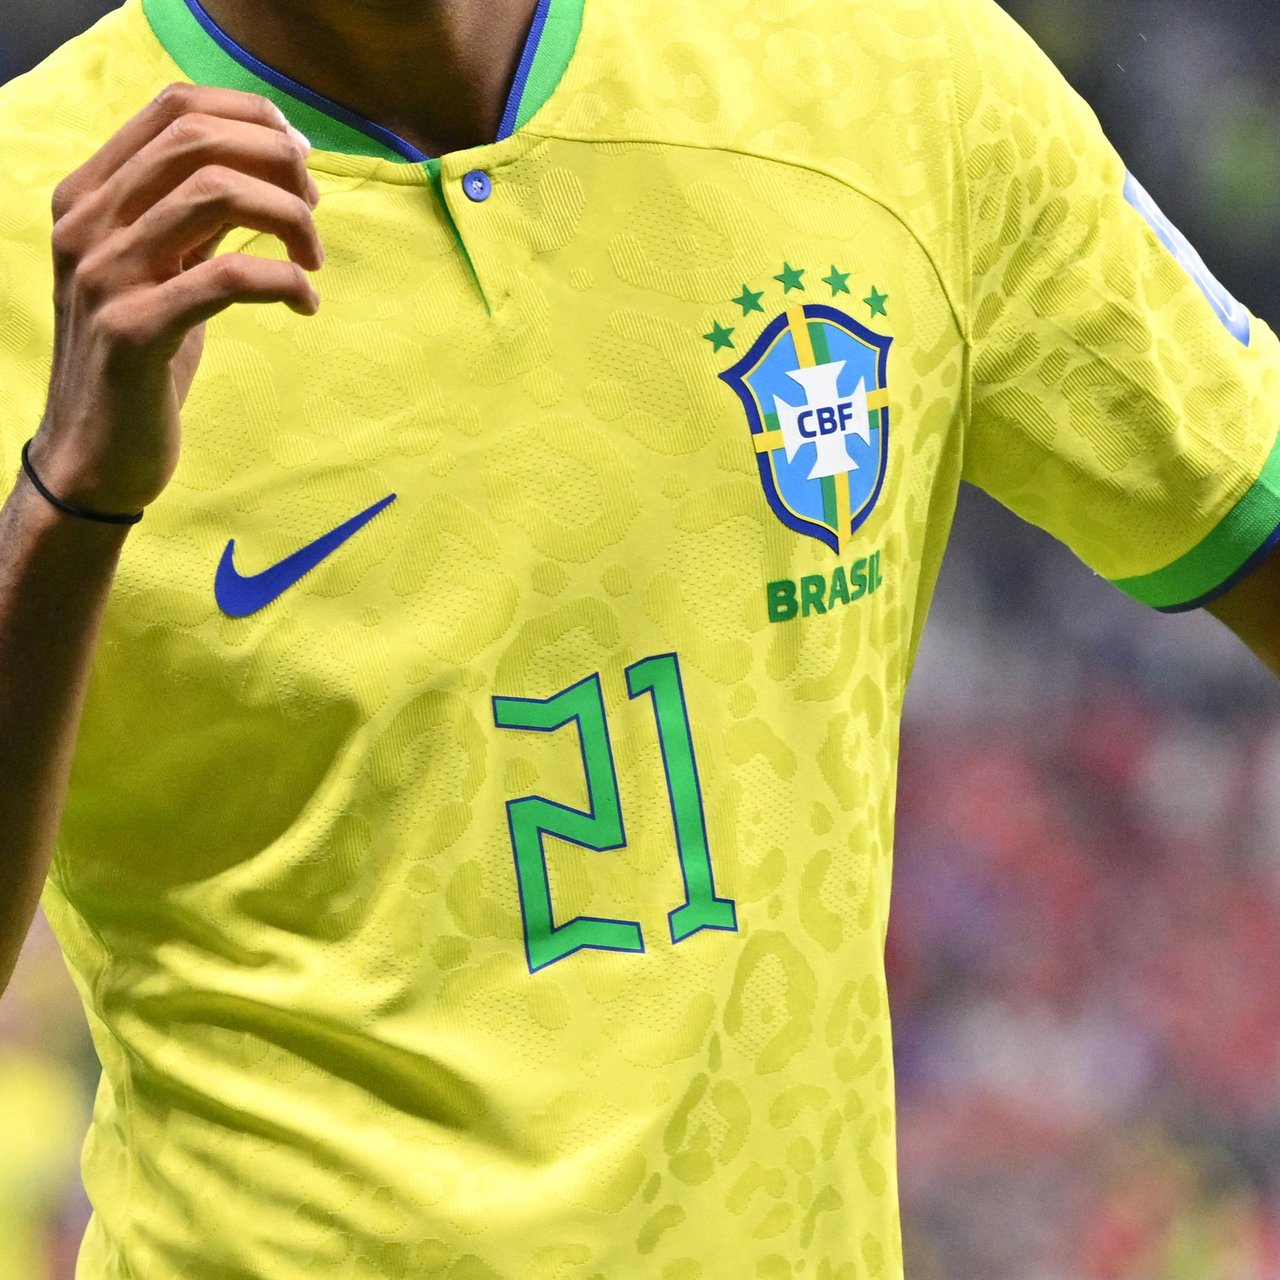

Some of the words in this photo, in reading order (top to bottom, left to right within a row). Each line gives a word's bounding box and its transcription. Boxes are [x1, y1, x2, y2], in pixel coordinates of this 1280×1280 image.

[796, 401, 853, 439] CBF
[766, 549, 883, 624] BRASIL
[491, 651, 739, 975] 21
